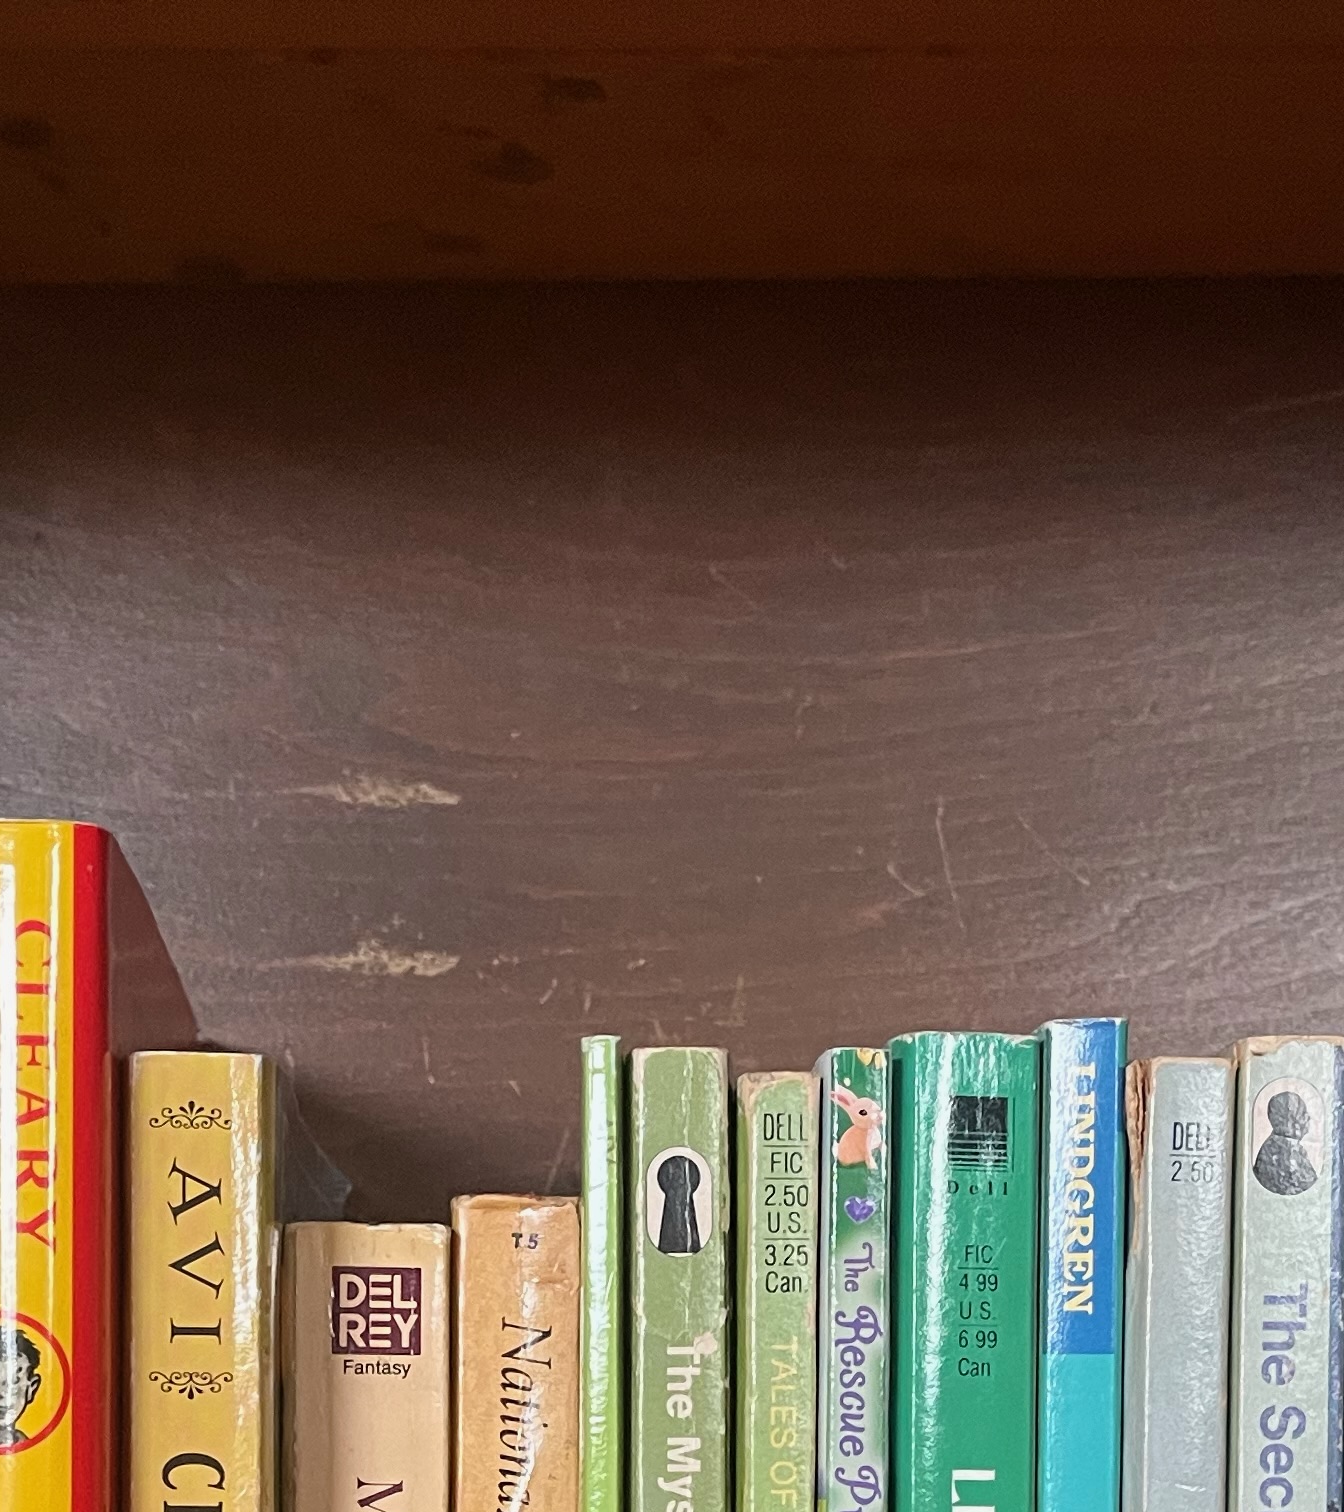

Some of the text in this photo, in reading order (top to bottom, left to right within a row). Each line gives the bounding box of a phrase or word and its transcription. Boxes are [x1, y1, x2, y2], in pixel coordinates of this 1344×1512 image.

[762, 1113, 809, 1141] DELL
[771, 1153, 804, 1174] FIC
[1062, 1062, 1096, 1314] LINDGREN
[168, 1158, 225, 1346] AVI
[338, 1273, 417, 1308] DEL
[843, 1254, 874, 1302] The
[338, 1314, 418, 1348] REY
[1260, 1283, 1308, 1385] The
[343, 1360, 411, 1379] Fantasy
[666, 1345, 702, 1418] The
[770, 1336, 798, 1448] TALES
[835, 1315, 883, 1467] Rescue
[770, 1461, 798, 1505] OF
